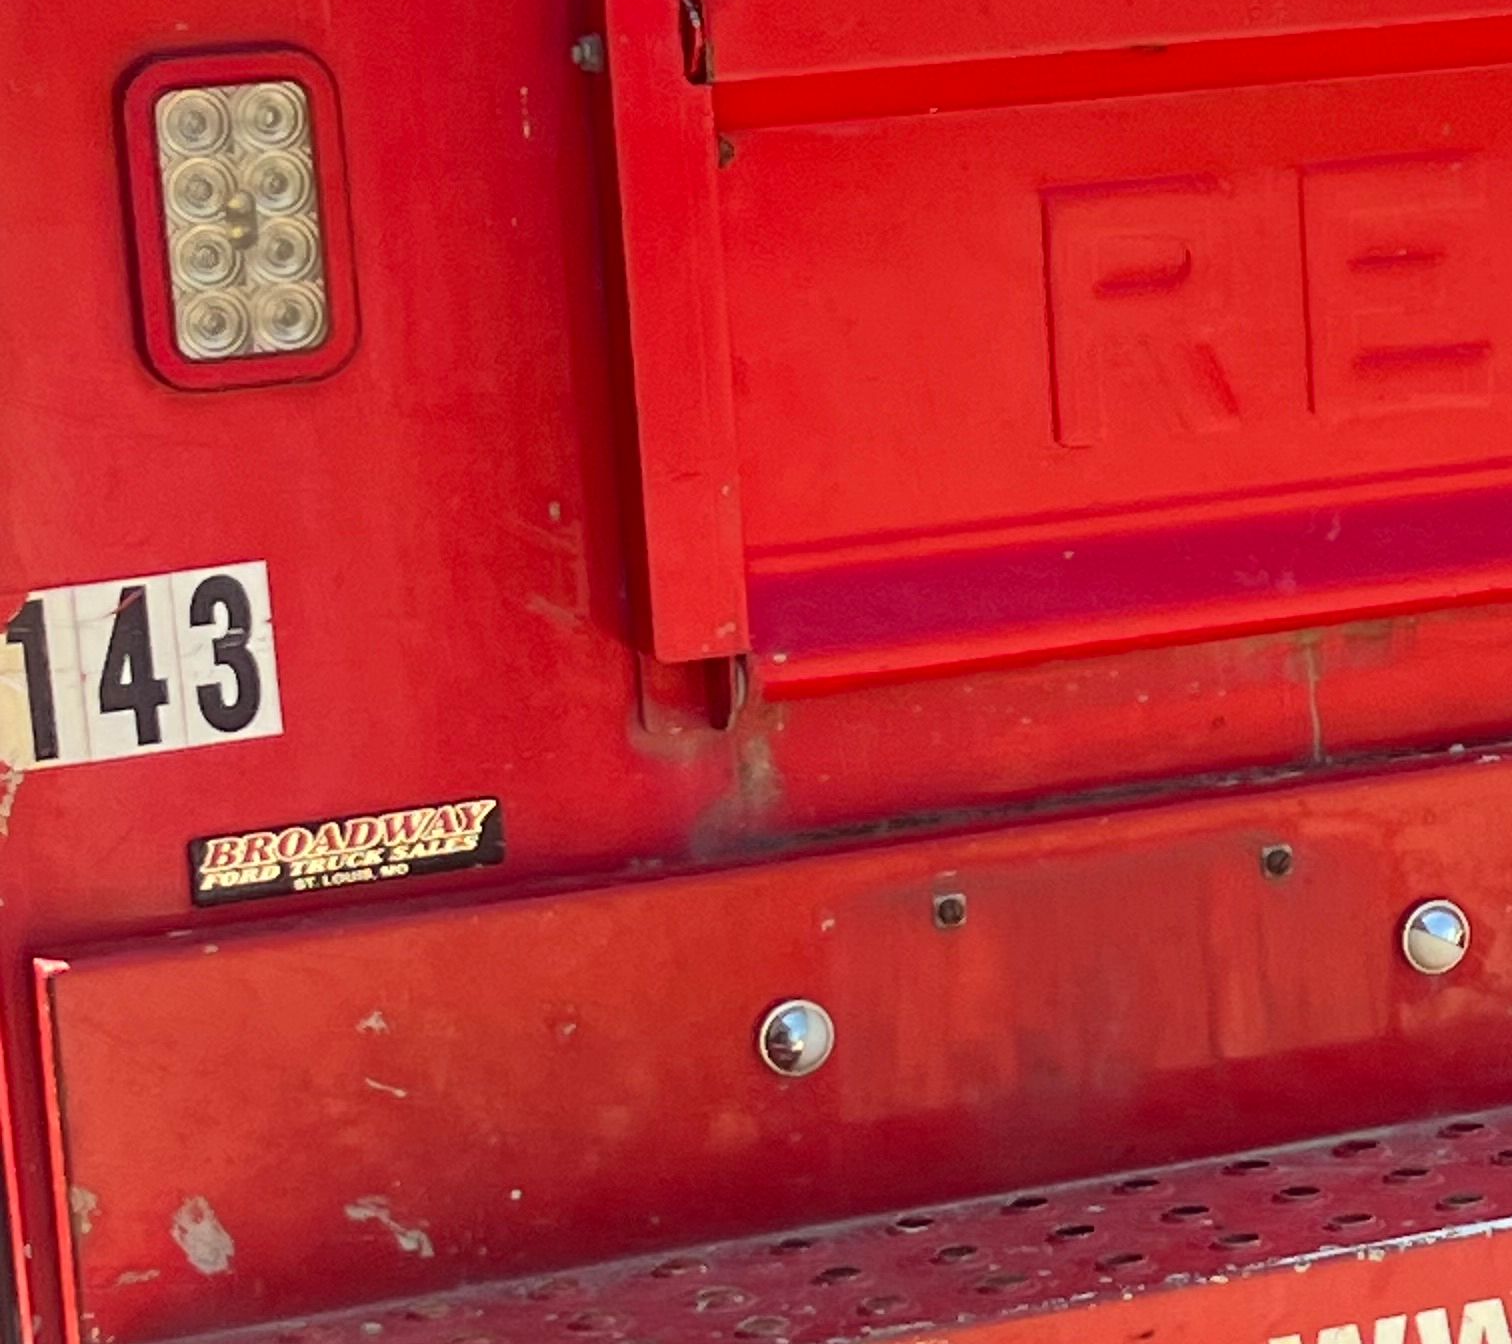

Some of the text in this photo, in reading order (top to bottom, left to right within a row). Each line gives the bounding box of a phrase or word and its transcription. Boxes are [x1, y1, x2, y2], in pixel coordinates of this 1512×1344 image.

[6, 574, 261, 761] 143
[200, 799, 496, 872] BROADWAY
[200, 834, 479, 891] FORD TRUCK SALES
